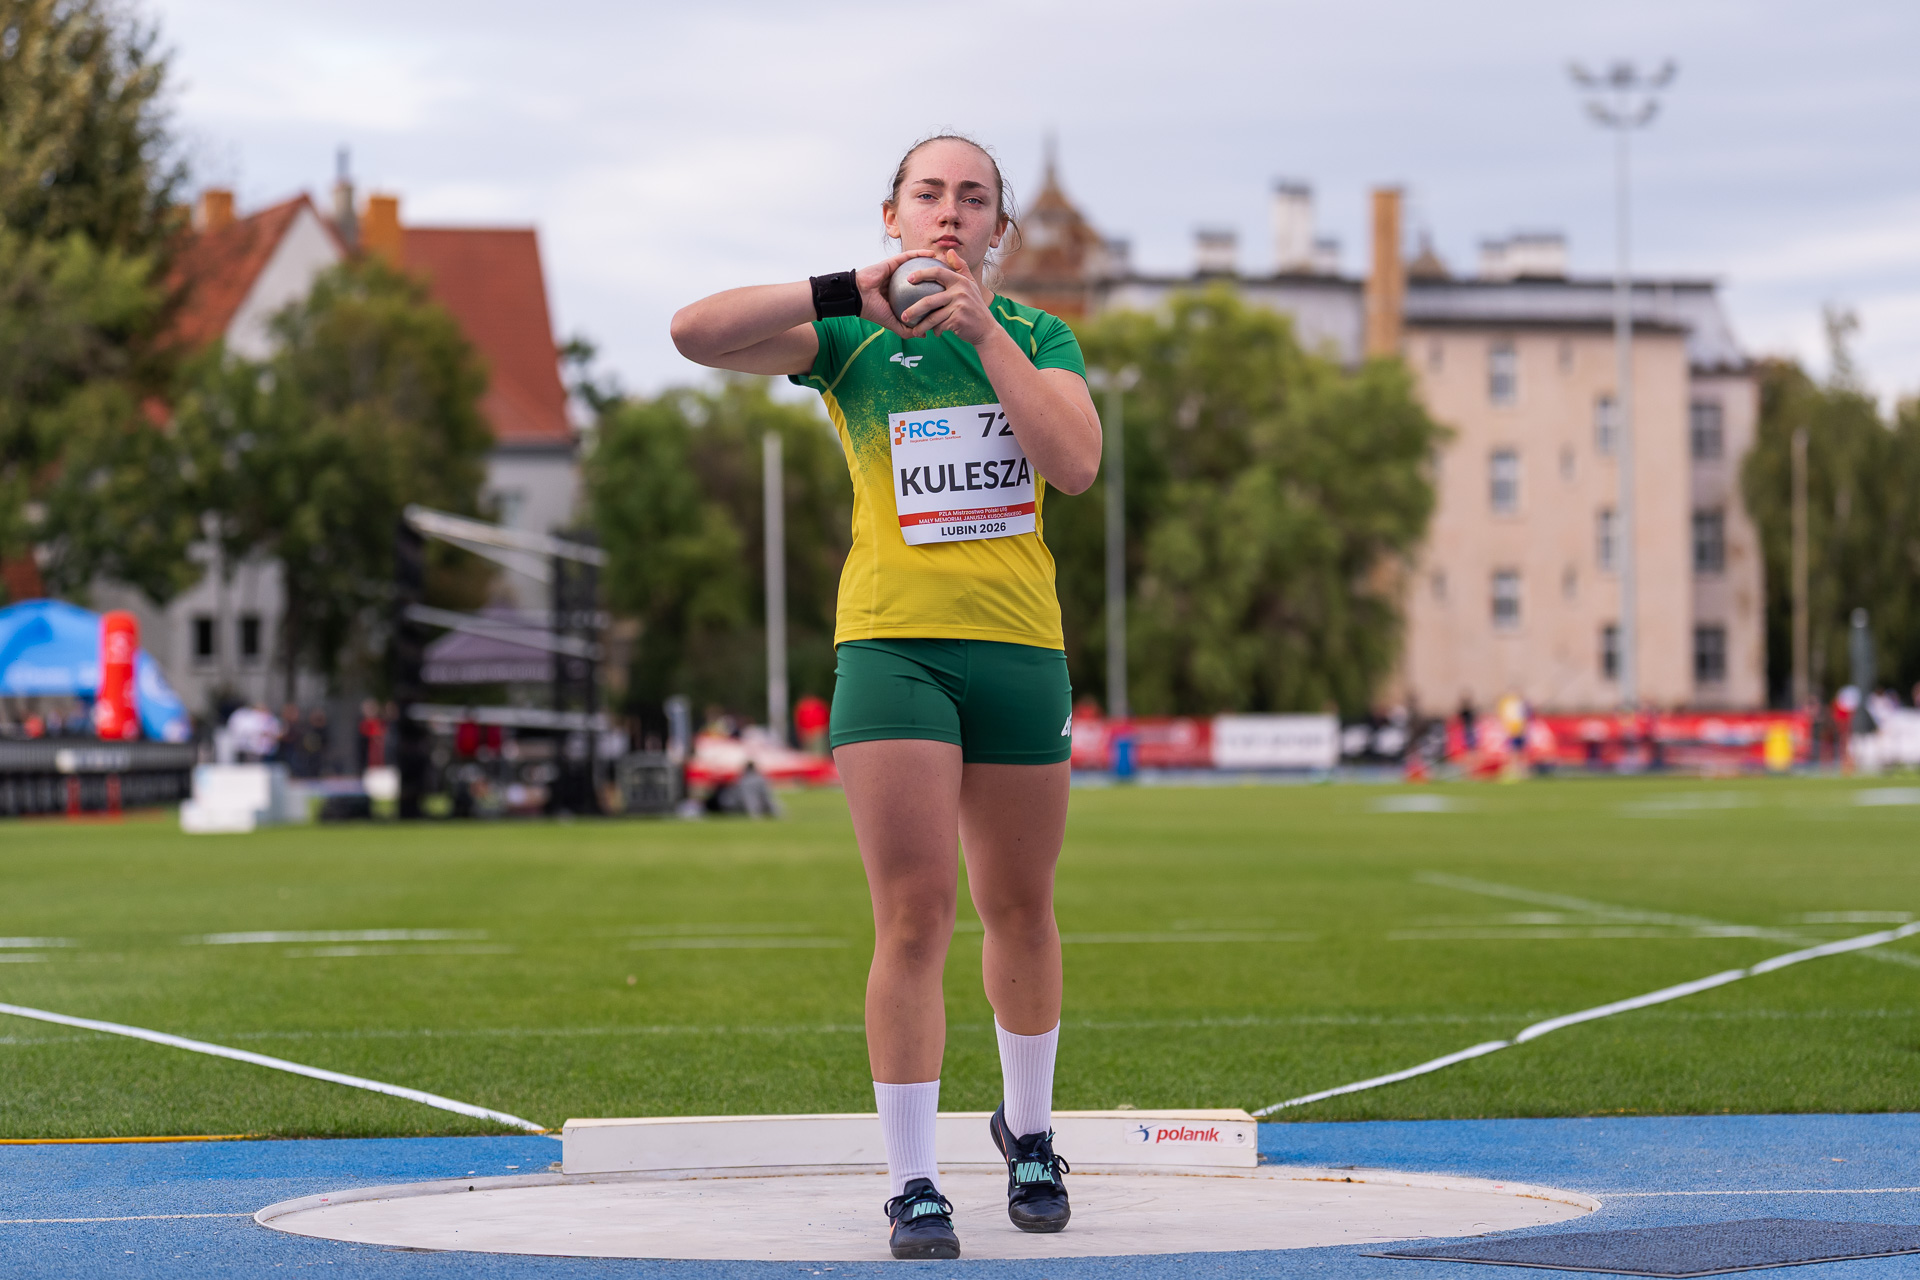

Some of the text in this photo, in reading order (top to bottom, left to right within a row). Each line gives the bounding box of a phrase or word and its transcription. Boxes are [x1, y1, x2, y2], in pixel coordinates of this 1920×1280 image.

[900, 457, 1031, 496] KULESZA
[952, 508, 984, 516] Mistrzostwa
[941, 522, 1007, 536] LUBIN 2026
[1156, 1126, 1220, 1143] polanik
